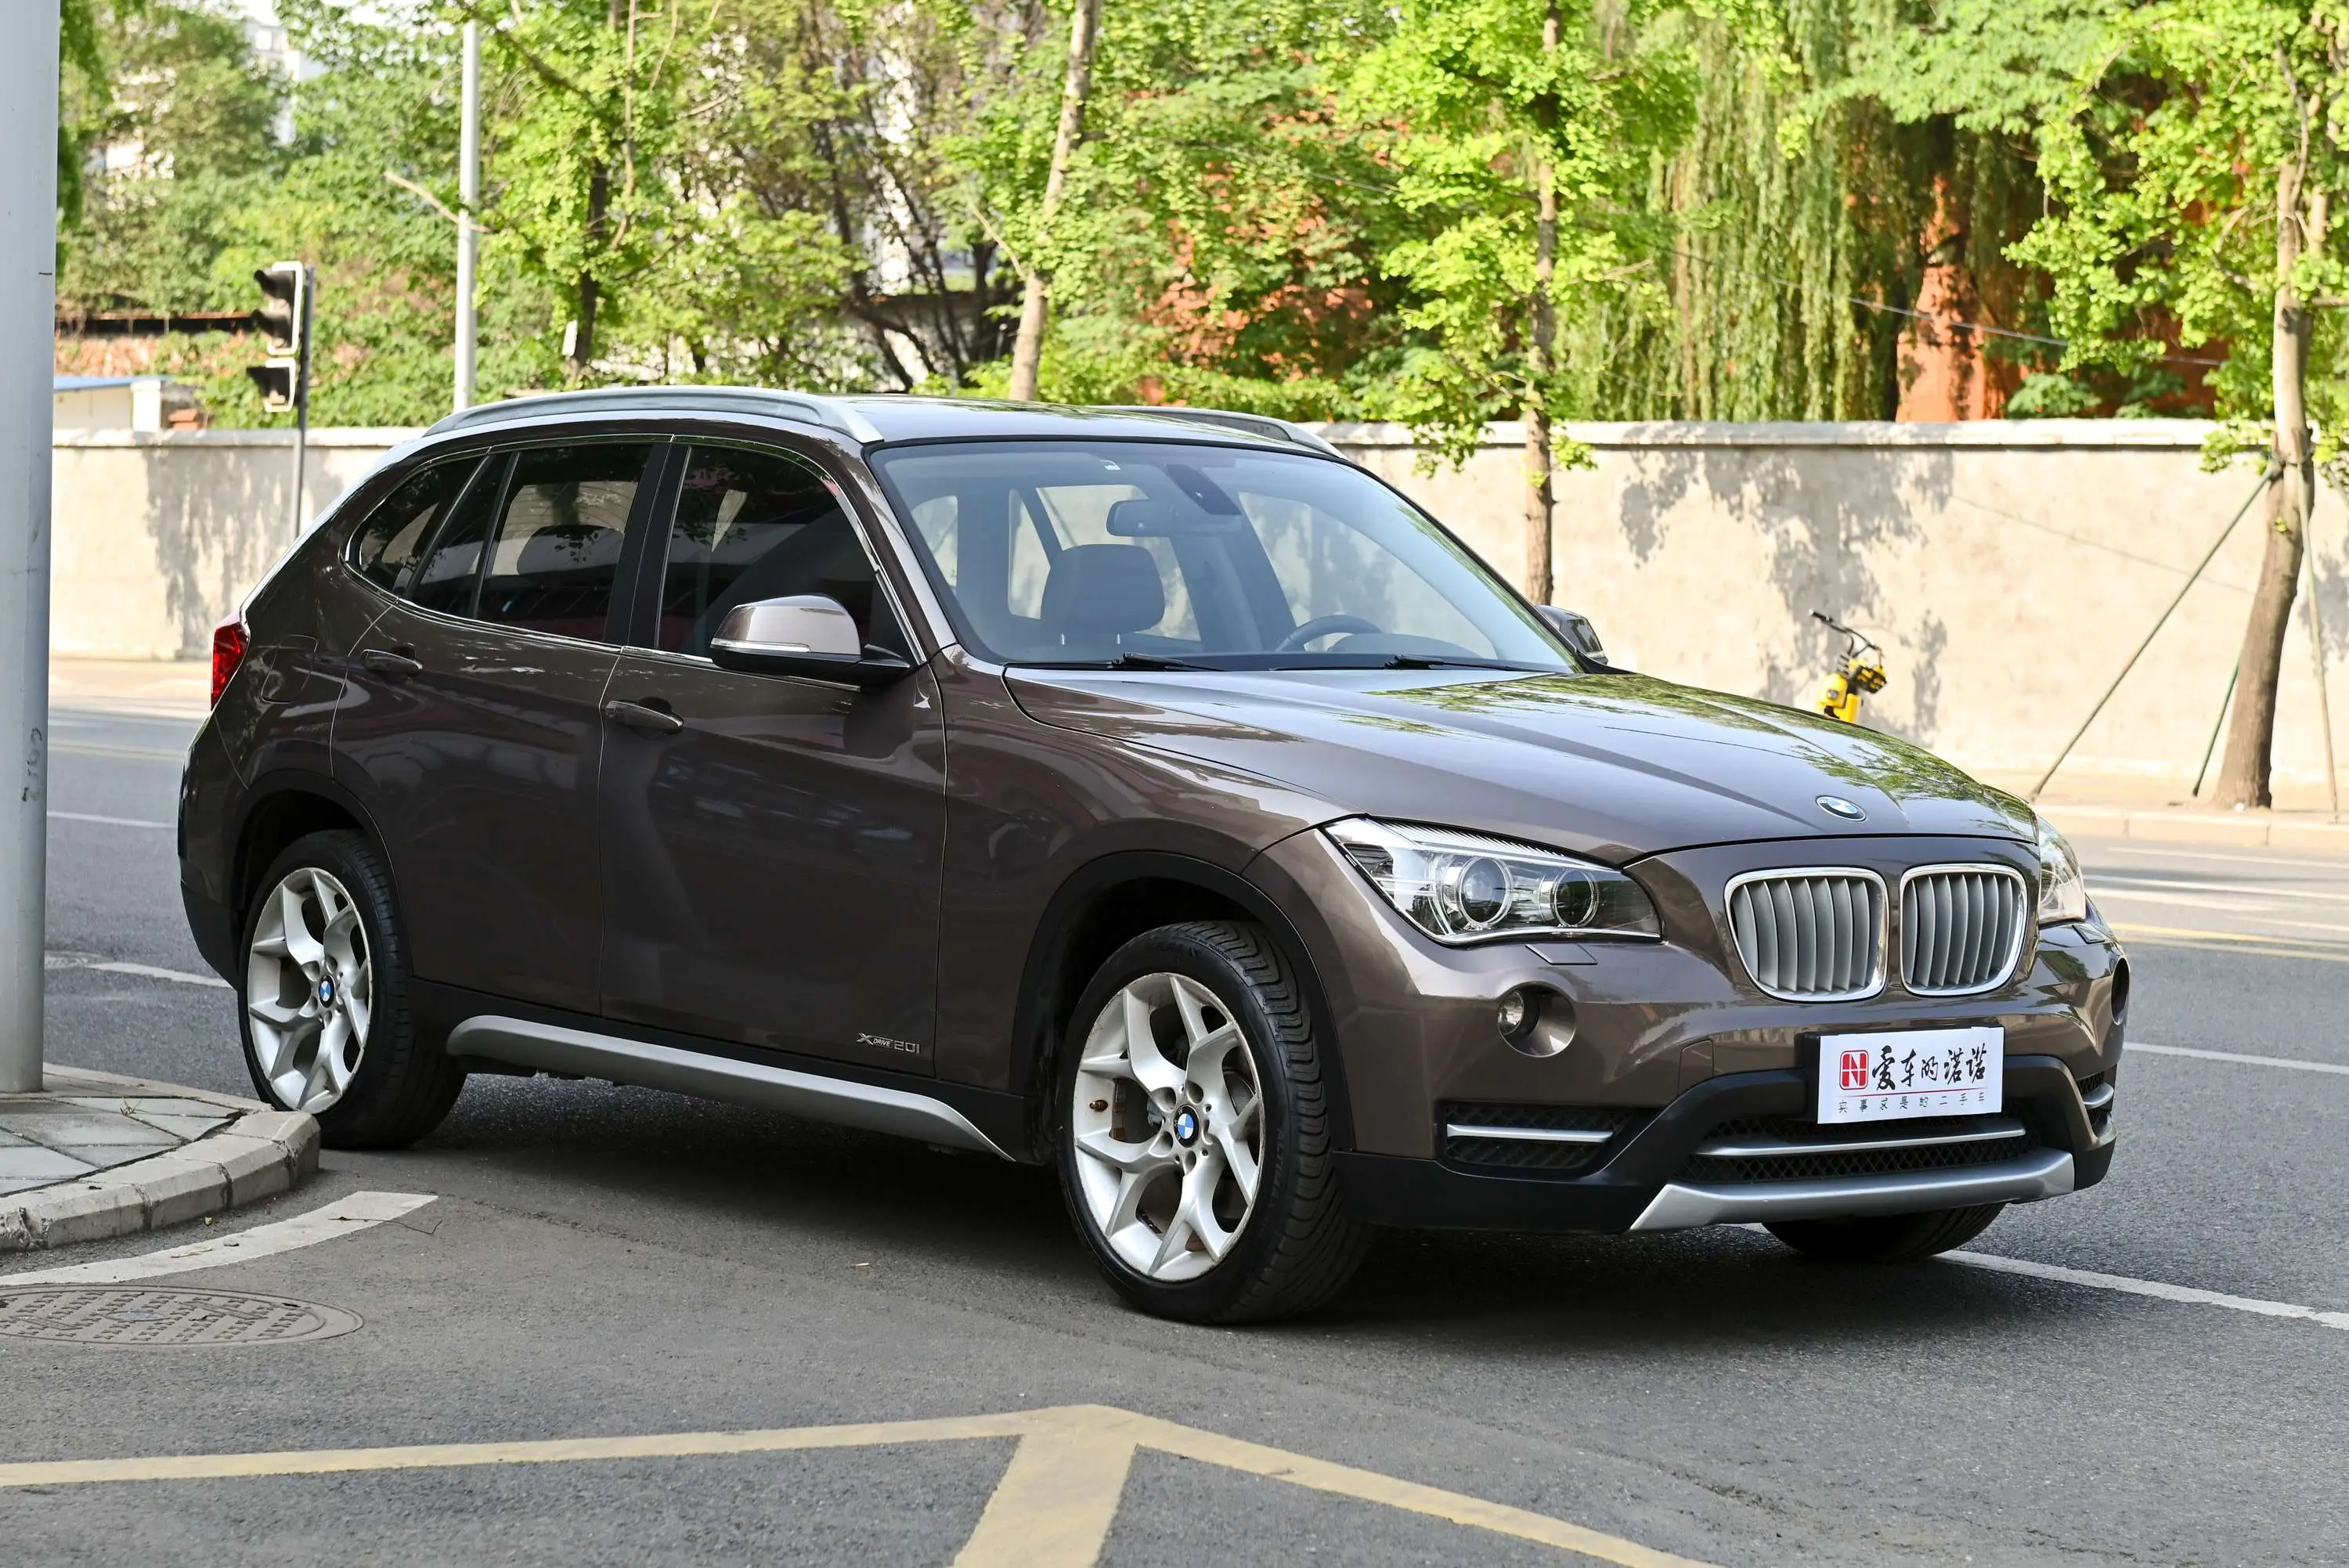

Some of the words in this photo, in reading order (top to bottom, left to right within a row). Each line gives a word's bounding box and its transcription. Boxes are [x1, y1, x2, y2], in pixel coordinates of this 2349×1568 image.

[1871, 1044, 1987, 1090] 爱车的诺诺
